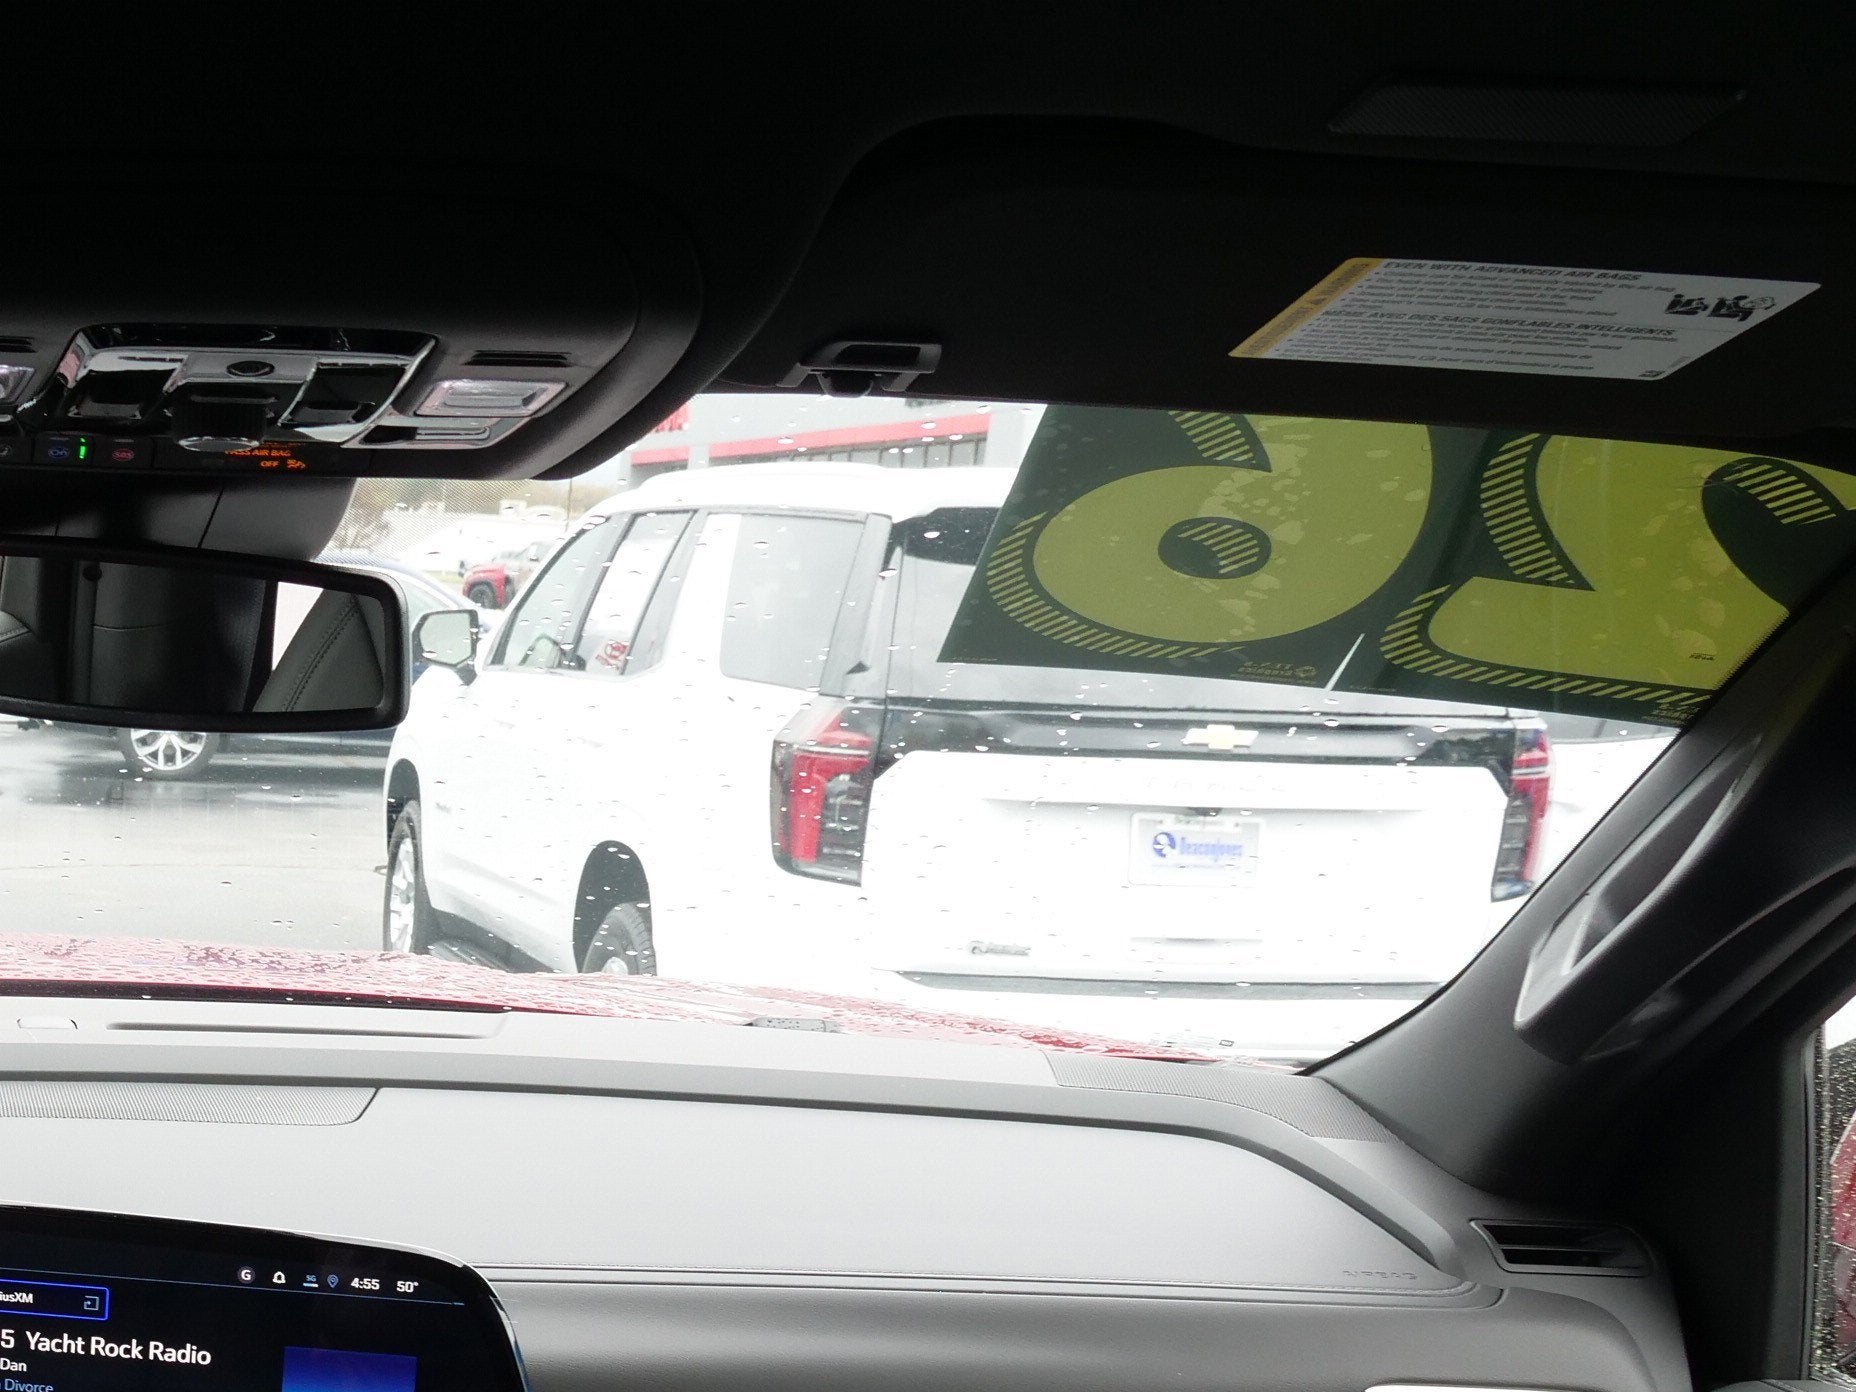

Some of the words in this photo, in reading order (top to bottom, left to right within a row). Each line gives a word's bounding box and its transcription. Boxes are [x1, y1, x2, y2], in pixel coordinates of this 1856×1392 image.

[260, 460, 280, 468] OFF
[350, 1277, 381, 1291] 4:55
[396, 1280, 419, 1293] 50°
[25, 1330, 86, 1355] Yacht
[90, 1336, 143, 1360] Rock
[148, 1342, 212, 1366] Radio
[0, 1358, 27, 1372] Dan
